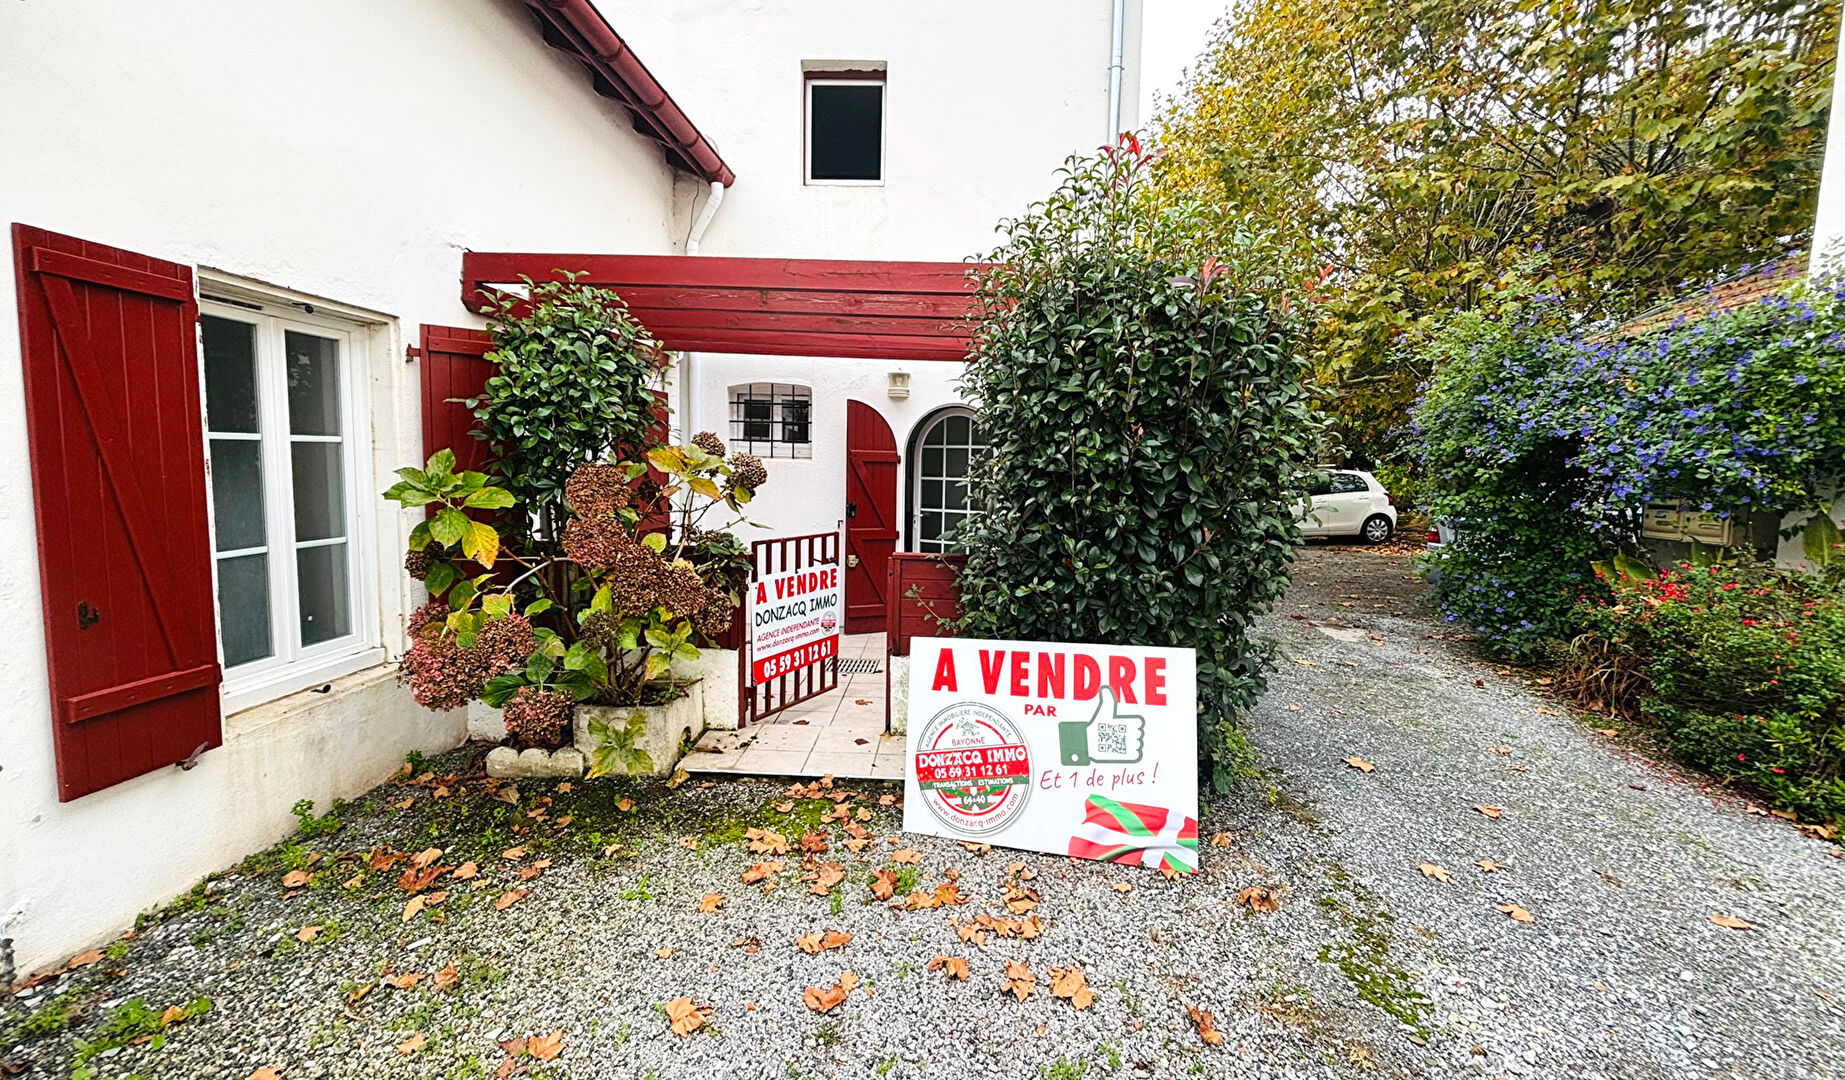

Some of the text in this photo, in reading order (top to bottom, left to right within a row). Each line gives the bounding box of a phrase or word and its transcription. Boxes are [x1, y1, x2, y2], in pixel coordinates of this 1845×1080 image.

[756, 568, 837, 605] A VENDRE
[756, 601, 806, 627] DONZACQ
[810, 593, 837, 612] IMMO
[757, 629, 781, 642] AGENCE
[781, 618, 820, 635] INDEPENDANTE
[764, 640, 831, 678] 05 59 31 12 61
[932, 648, 1167, 706] A VENDRE
[1024, 704, 1057, 717] PAR
[926, 726, 939, 748] AGENCE
[952, 737, 985, 746] BAYONNE
[918, 746, 1026, 768] DONZACQ IMMO
[935, 764, 1008, 778] 05 59 31 12 61
[1040, 762, 1159, 790] Et 1 de plus !
[932, 778, 1014, 788] TRANSACTIONS ESTIMATIONS
